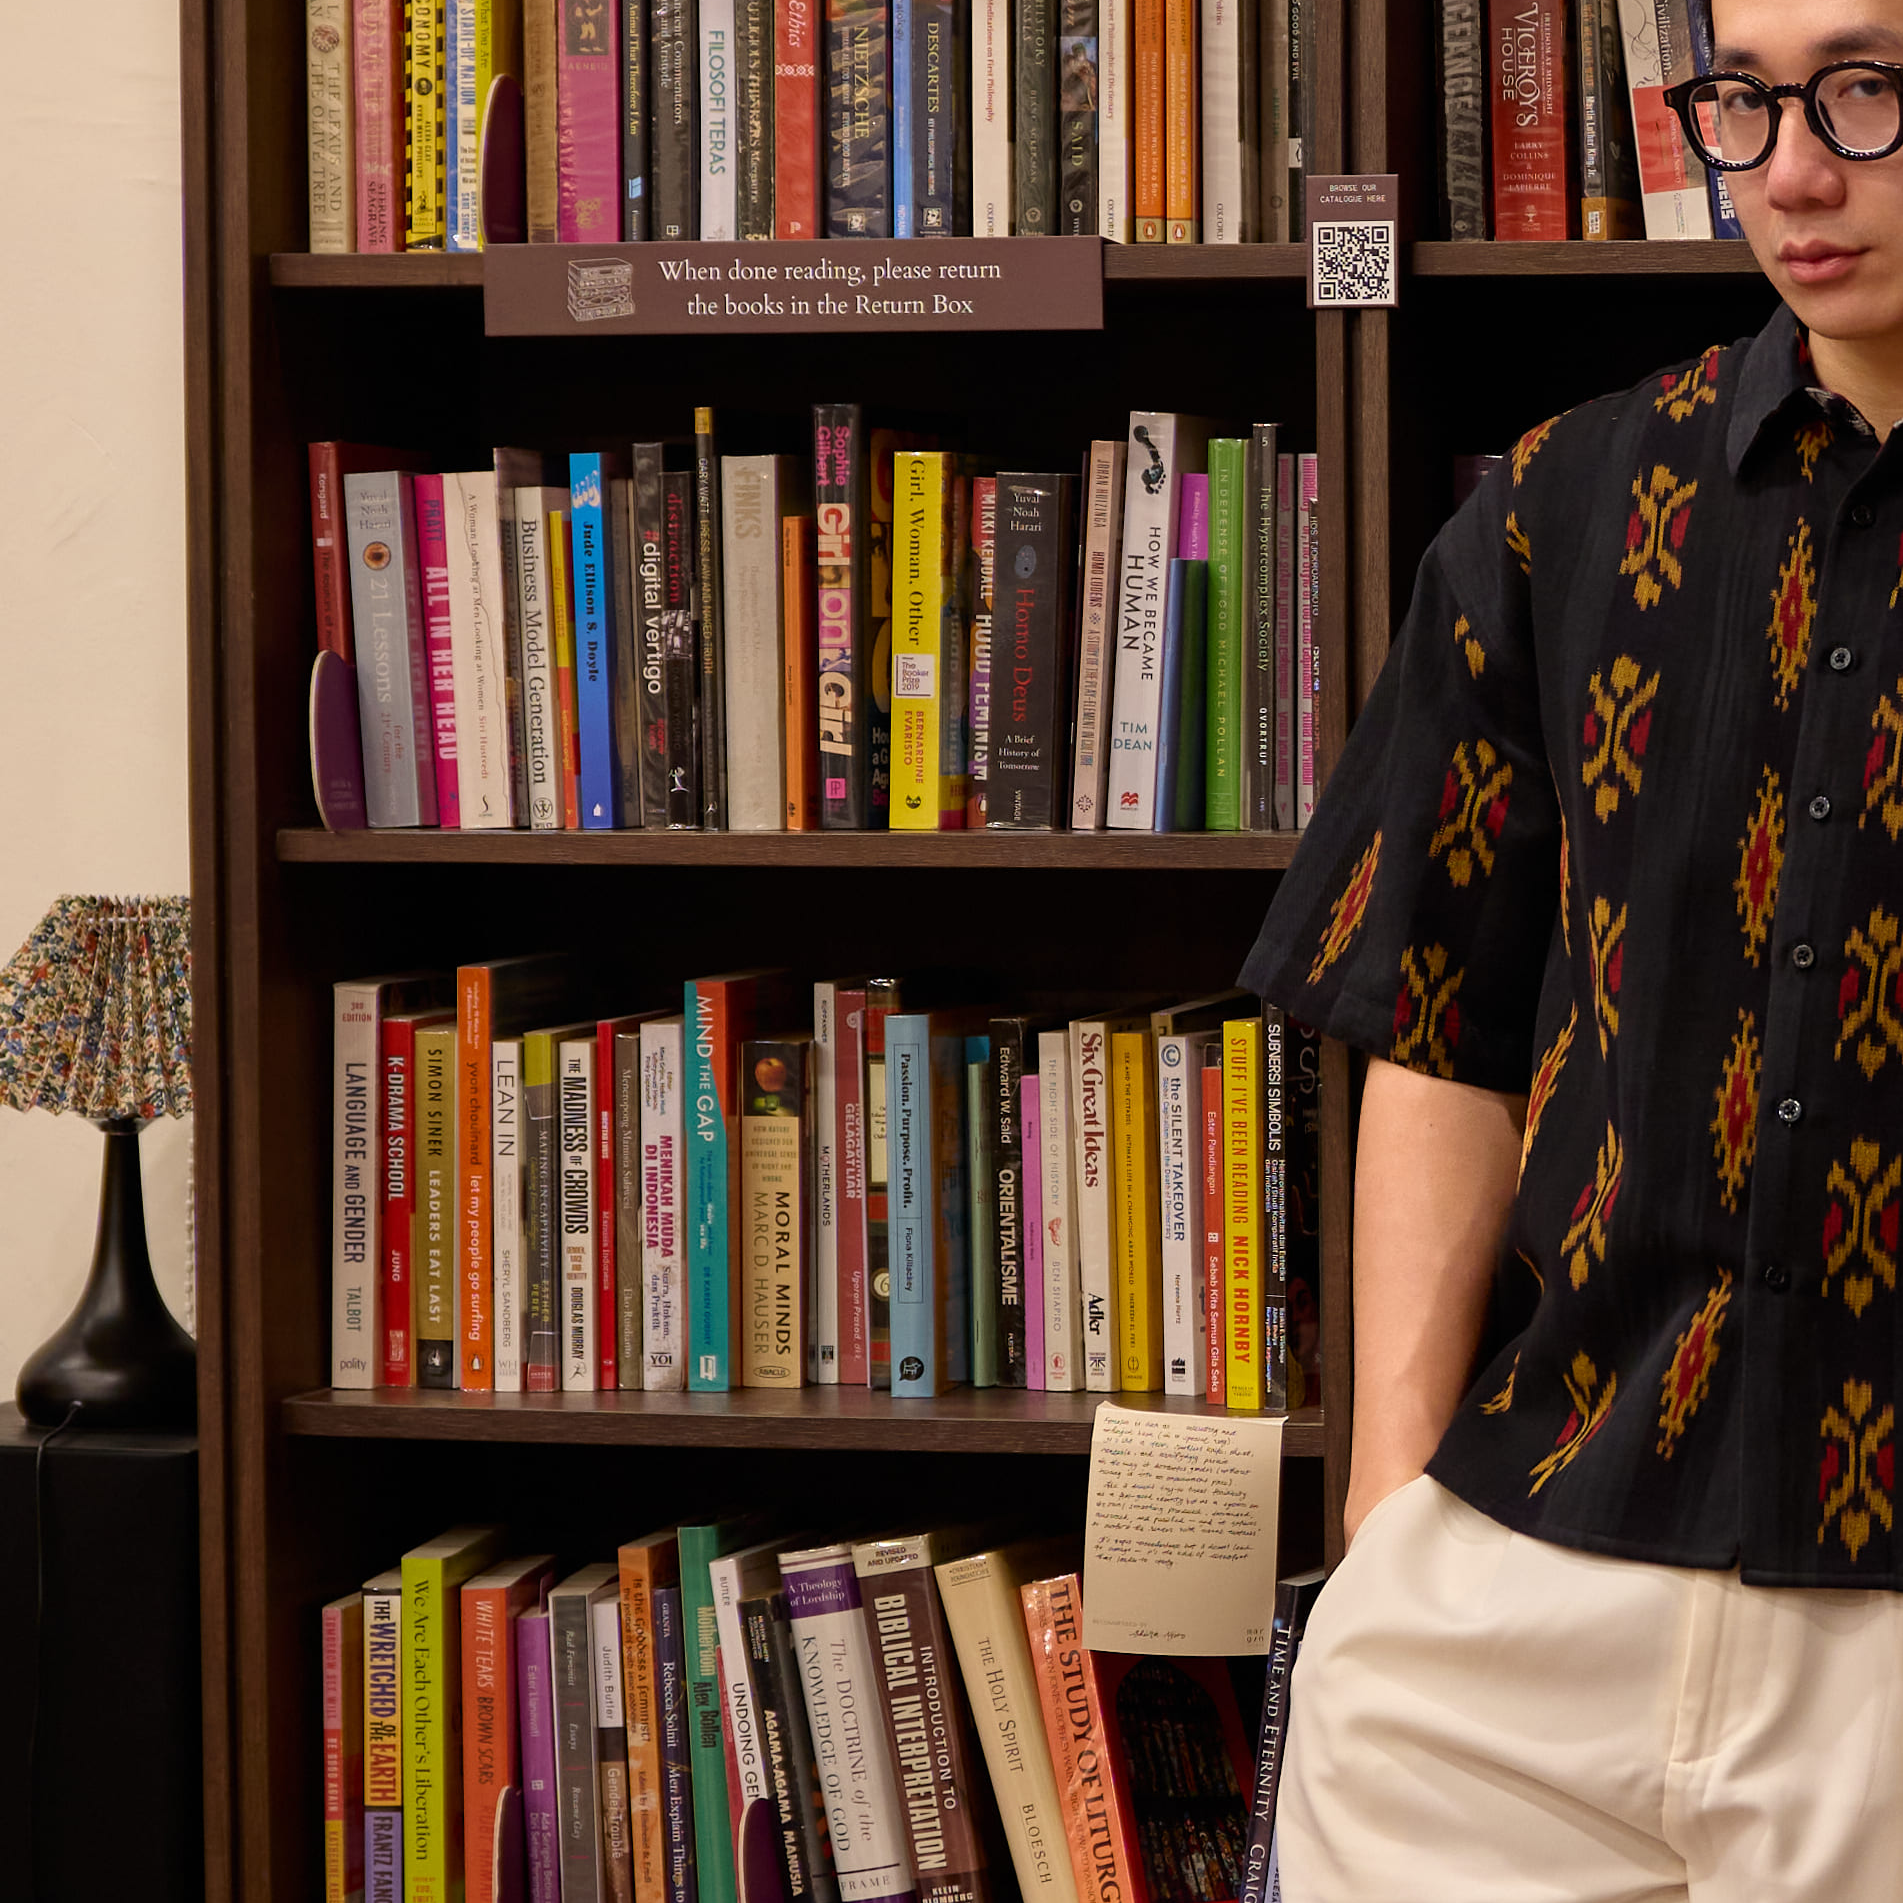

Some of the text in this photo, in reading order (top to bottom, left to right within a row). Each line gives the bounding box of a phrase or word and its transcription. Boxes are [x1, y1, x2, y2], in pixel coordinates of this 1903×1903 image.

[788, 0, 804, 47] Ethics
[854, 26, 870, 139] NIETZSCHE
[927, 22, 939, 113] DESCARTES
[1502, 28, 1514, 101] HOUSE
[1514, 2, 1540, 127] VICEROY'S
[709, 30, 725, 175] FILOSOFI TERAS
[1320, 195, 1363, 203] CATALOGUE
[1330, 184, 1358, 192] BROWSE
[658, 258, 1001, 287] When done reading, please return
[688, 293, 973, 315] the books in the Return Box
[907, 460, 925, 646] Girl, Woman, Other
[1122, 554, 1144, 651] HUMAN
[1141, 527, 1161, 681] HOW WE BECAME
[521, 520, 549, 784] Business Model Generation
[1012, 588, 1035, 722] Homo Deus
[904, 711, 913, 765] EVARISTO
[915, 711, 924, 784] BERNARDINE
[428, 1049, 442, 1156] SIMON SINEK
[696, 995, 714, 1142] MIND THE GAP
[1082, 1032, 1105, 1188] Six Great Ideas
[344, 1062, 366, 1263] LANGUAGE AND GENDER
[388, 1056, 404, 1201] K-DRAMA SCHOOL
[391, 1249, 401, 1281] JUNG
[428, 1170, 441, 1323] LEADERS EAT LAST
[775, 1191, 790, 1355] MORAL MINDS
[346, 1287, 361, 1331] TALBOT
[1088, 1293, 1104, 1335] Adler
[873, 1594, 947, 1871] BIBLICAL INTERPRETATION
[920, 1646, 956, 1810] INTRODUCTION TO
[978, 1637, 1024, 1773] THE HOLY SPIRIT
[1254, 1625, 1292, 1822] TIME AND ETERNITY
[1022, 1804, 1052, 1884] BLOESCH
